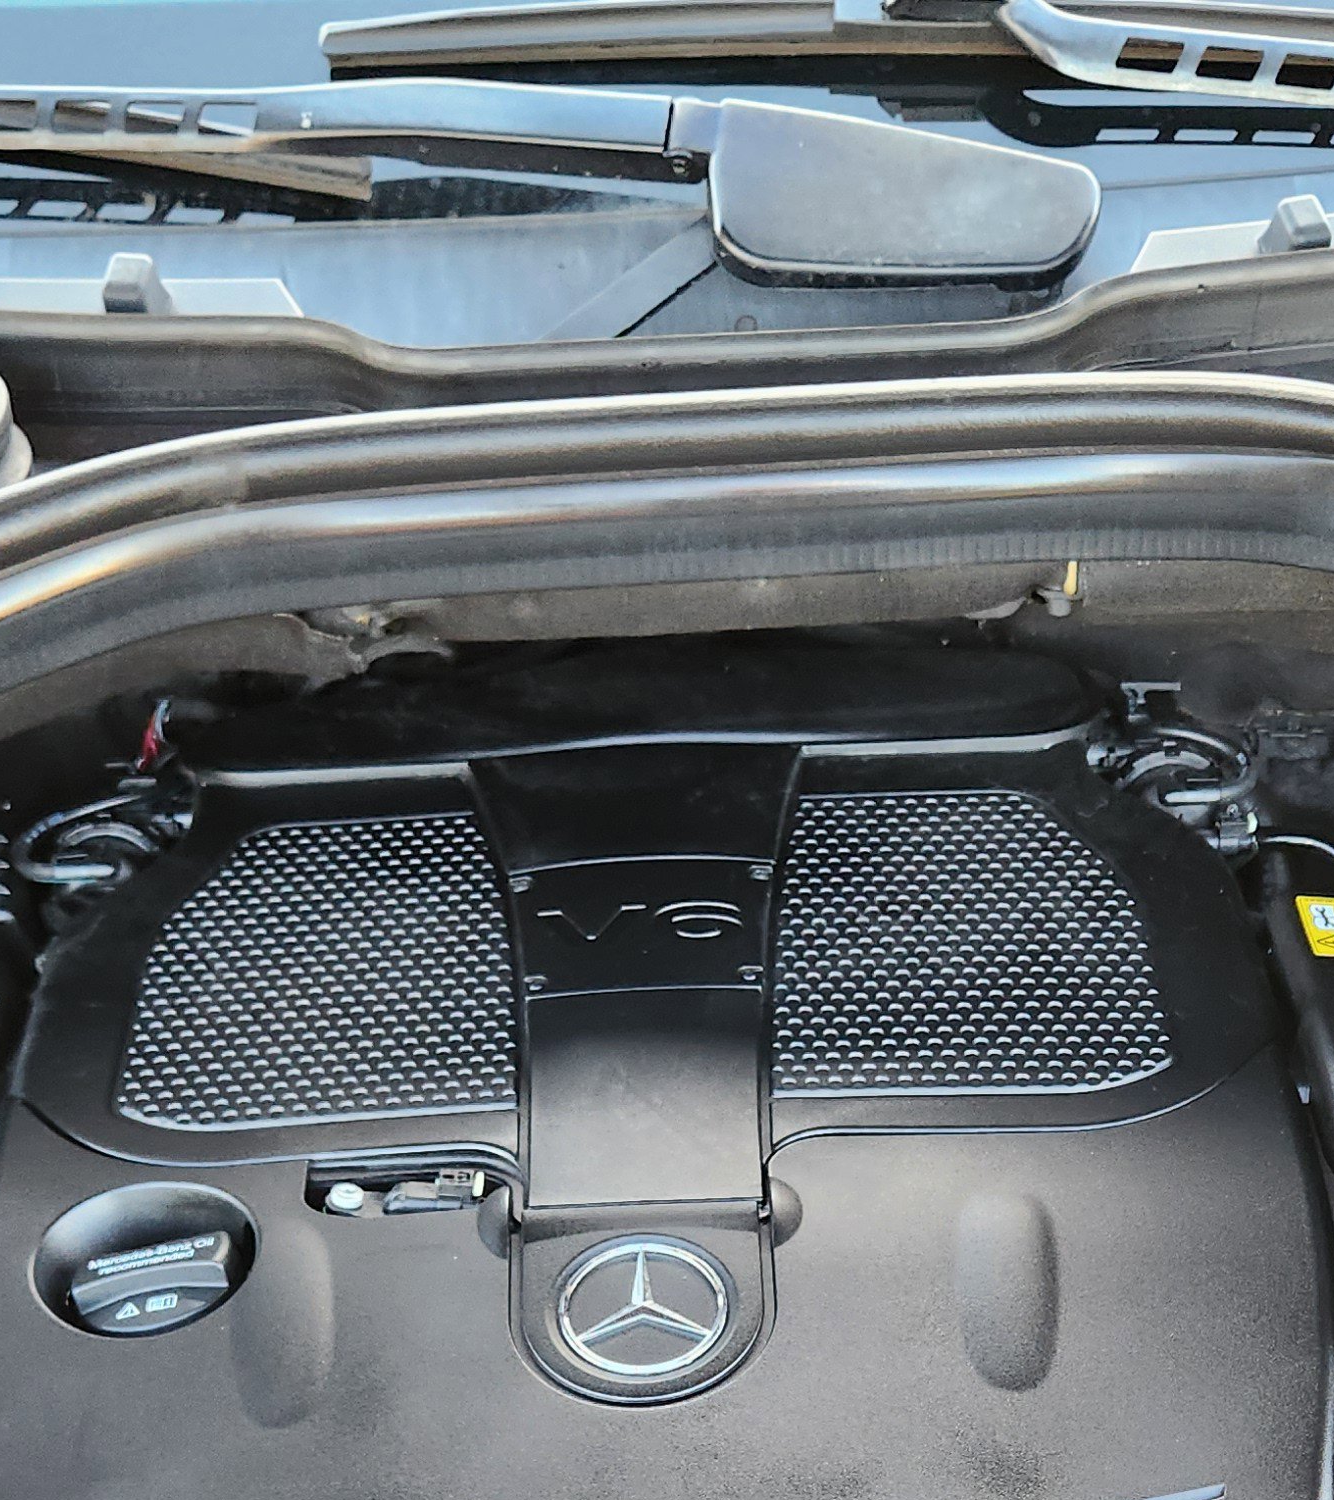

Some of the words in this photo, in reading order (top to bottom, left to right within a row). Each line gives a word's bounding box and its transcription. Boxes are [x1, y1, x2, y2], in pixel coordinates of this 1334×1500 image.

[88, 1242, 192, 1270] Mercedes-Benz
[193, 1237, 215, 1249] Oil
[98, 1251, 195, 1275] recommended
